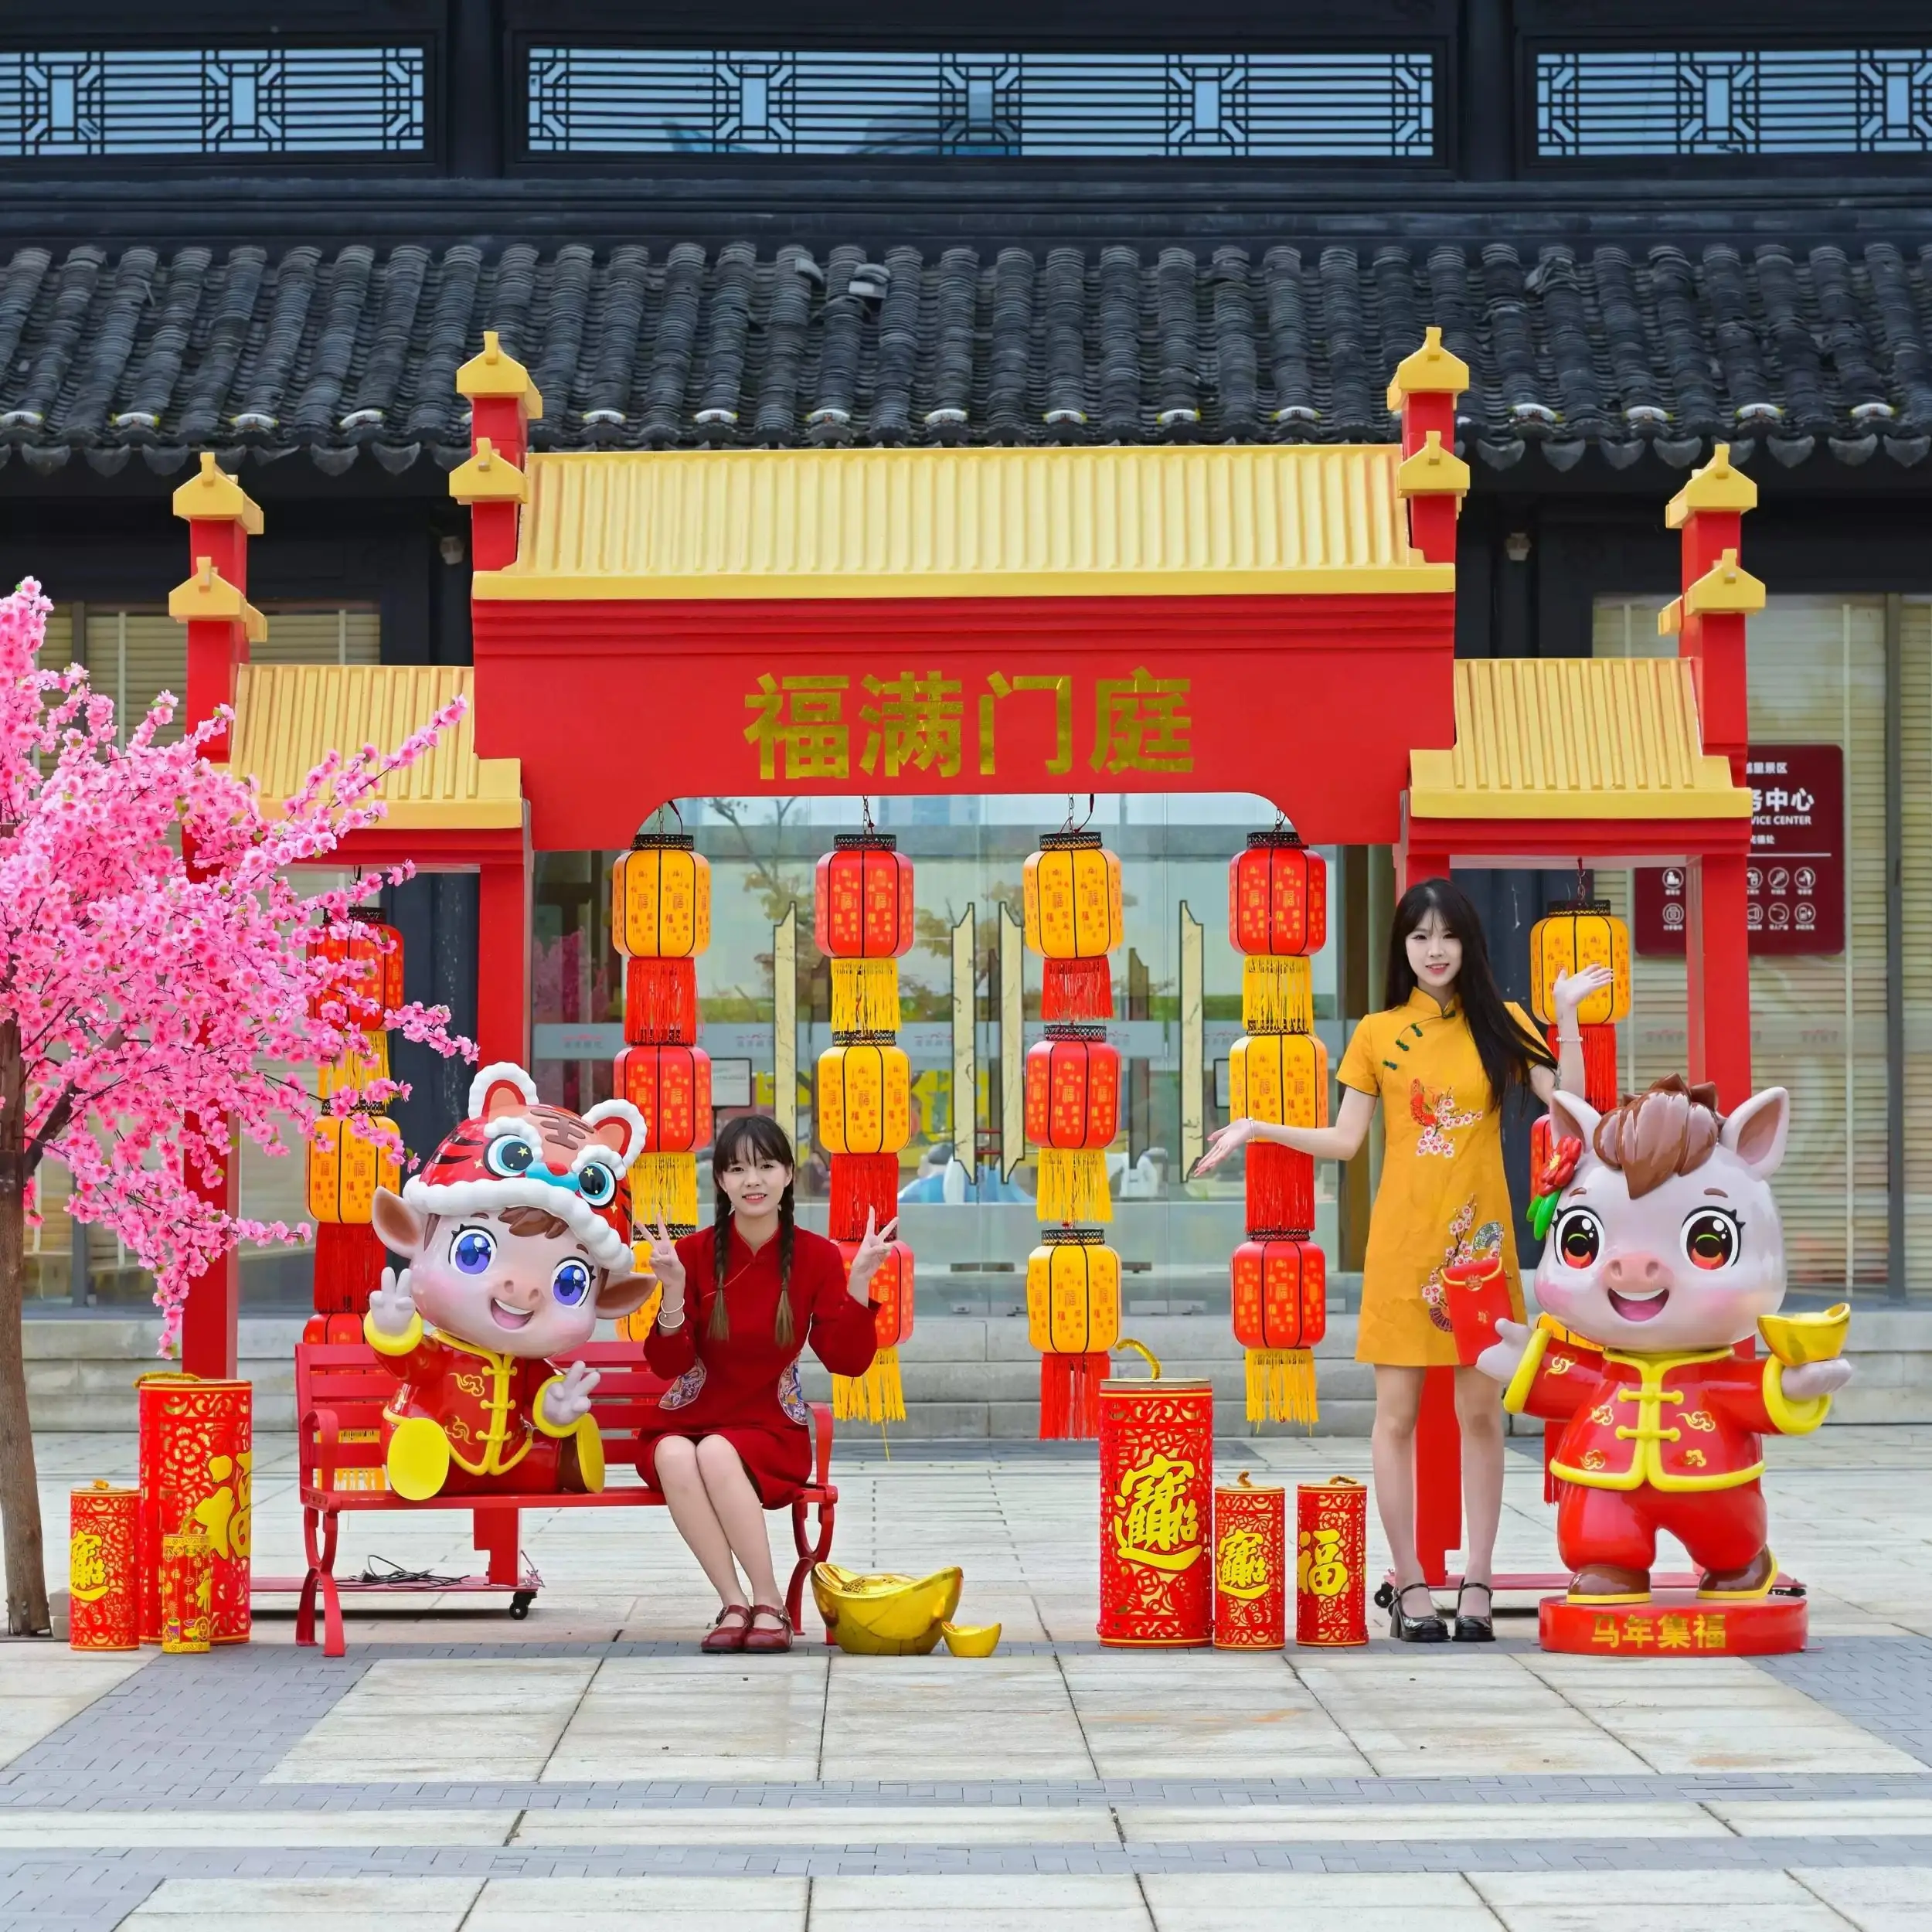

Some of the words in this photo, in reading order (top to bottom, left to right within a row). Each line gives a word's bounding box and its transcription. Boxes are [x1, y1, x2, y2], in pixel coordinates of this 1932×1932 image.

[744, 666, 1194, 780] 福满门庭
[1774, 815, 1811, 825] CENTER
[1296, 1529, 1350, 1597] 福
[1591, 1614, 1726, 1649] 马年集福
